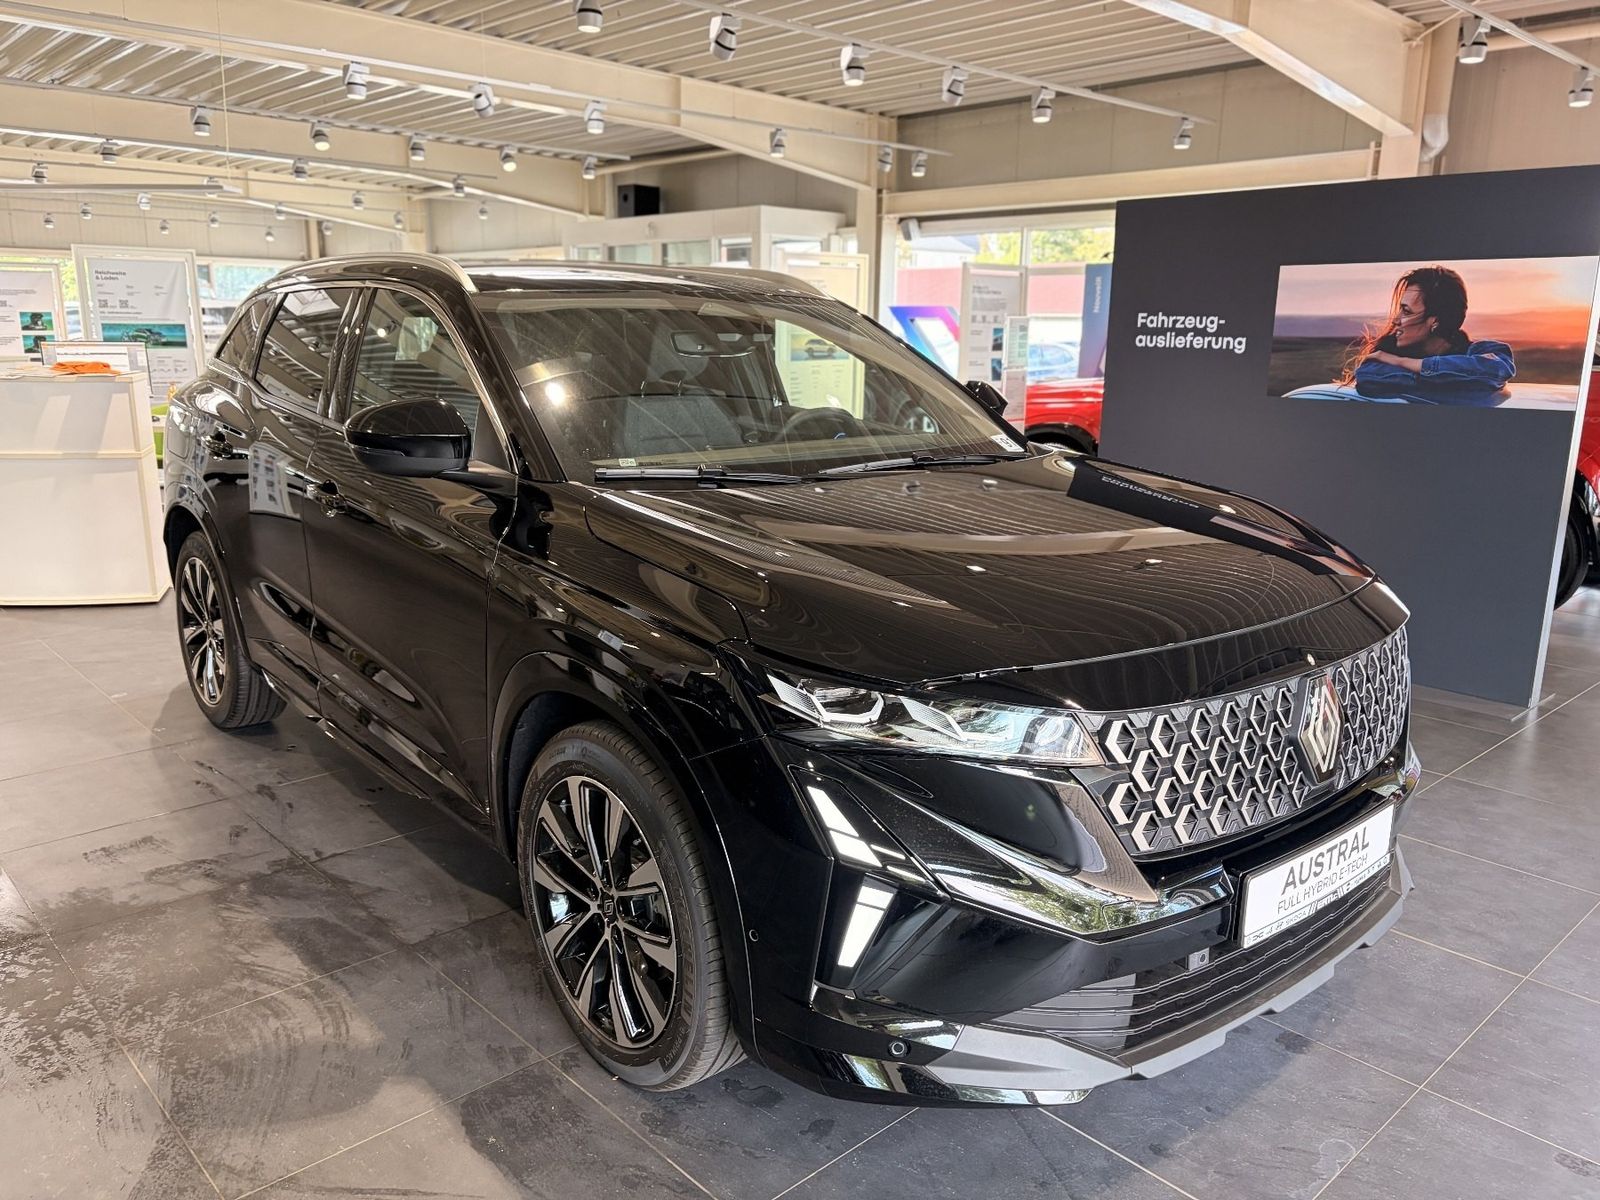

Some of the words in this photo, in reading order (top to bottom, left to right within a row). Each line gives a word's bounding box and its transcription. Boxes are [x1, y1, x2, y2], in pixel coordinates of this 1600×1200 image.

[1135, 332, 1247, 354] auslieferung
[1137, 312, 1226, 333] Fahrzeug-
[1281, 826, 1370, 896] AUSTRAL
[1277, 892, 1301, 914] FULL
[1303, 872, 1338, 900] HYBRID
[1339, 852, 1368, 880] E-TECH
